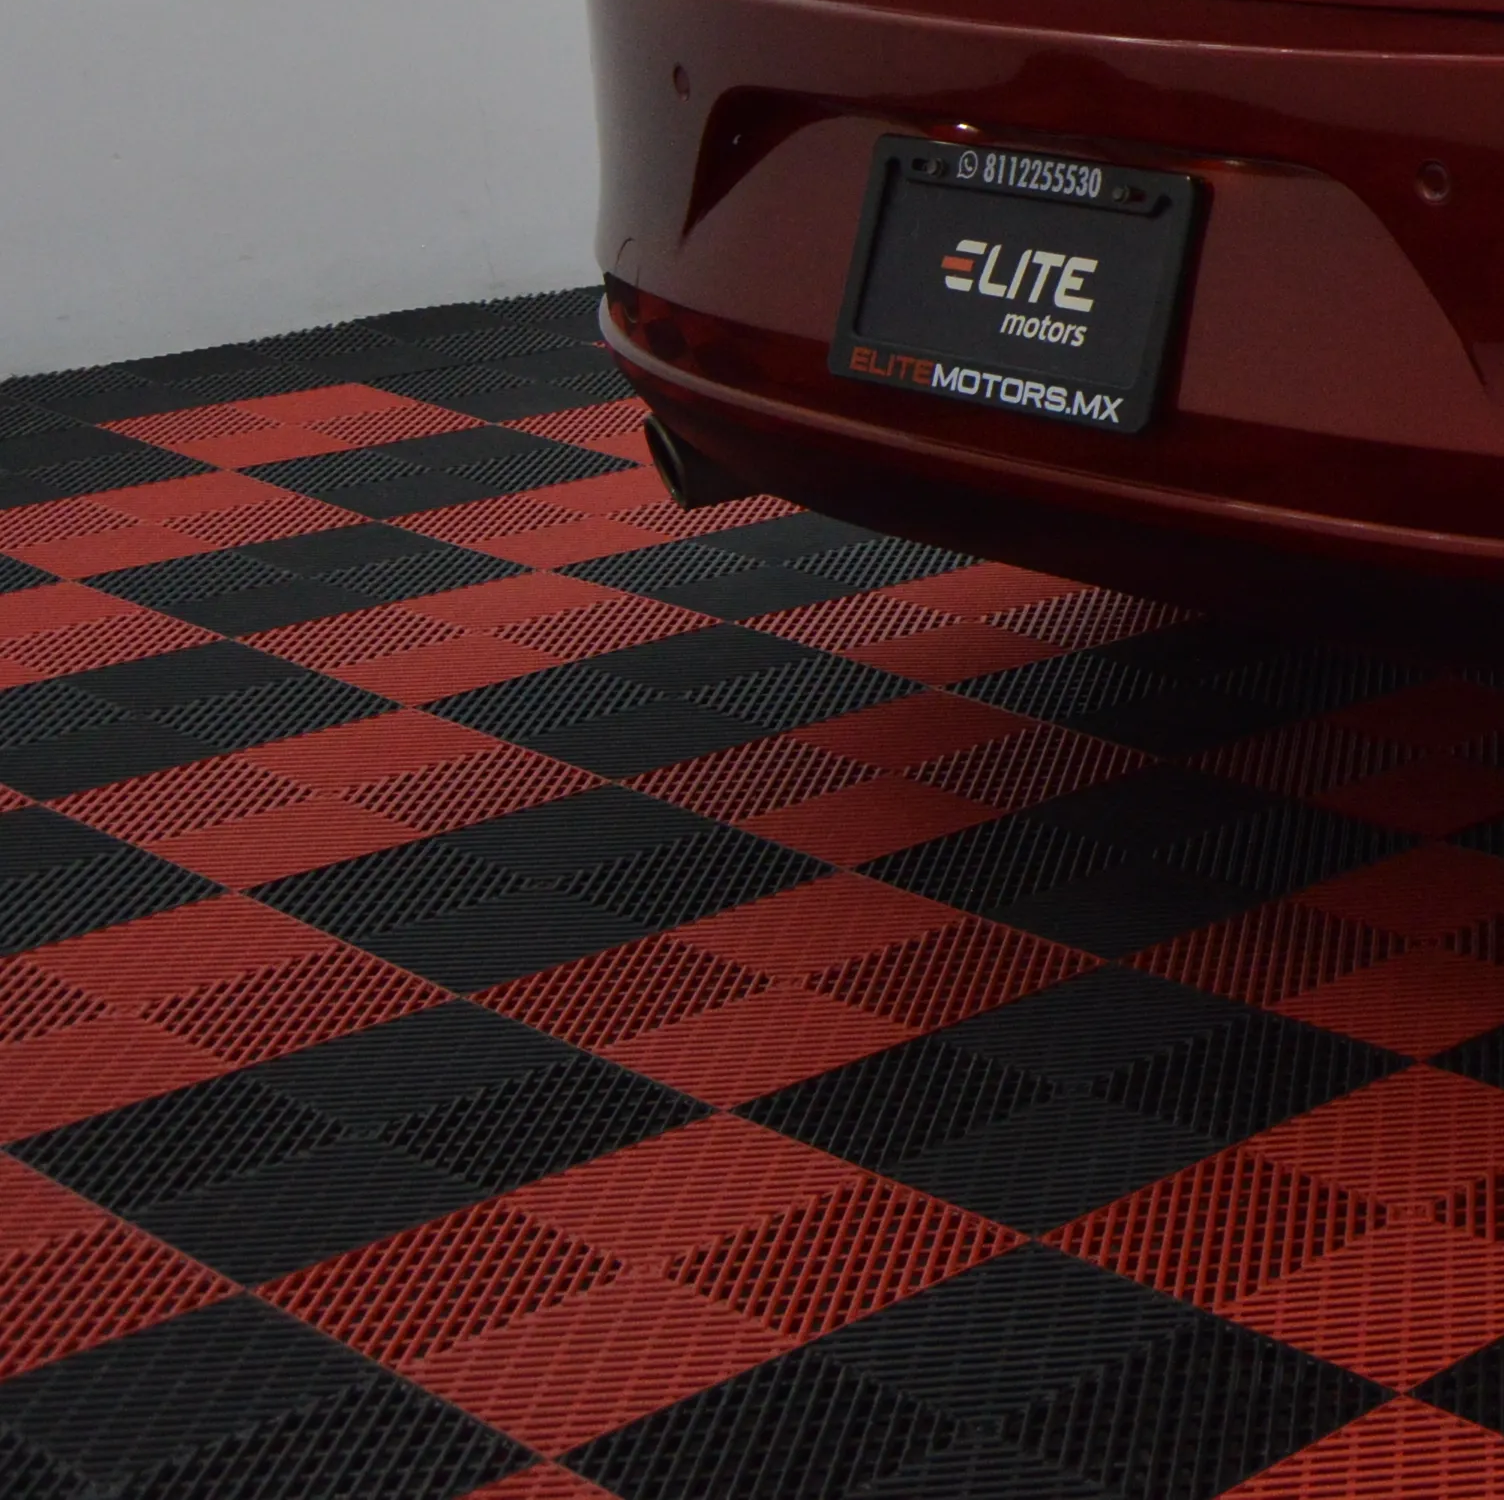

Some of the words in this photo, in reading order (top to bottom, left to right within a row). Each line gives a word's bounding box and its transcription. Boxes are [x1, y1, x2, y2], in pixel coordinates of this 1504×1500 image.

[983, 152, 1102, 198] 8112255530
[940, 238, 1099, 313] ELITE
[1000, 311, 1089, 347] motors
[850, 345, 1125, 424] ELITEMOTORS.MX
